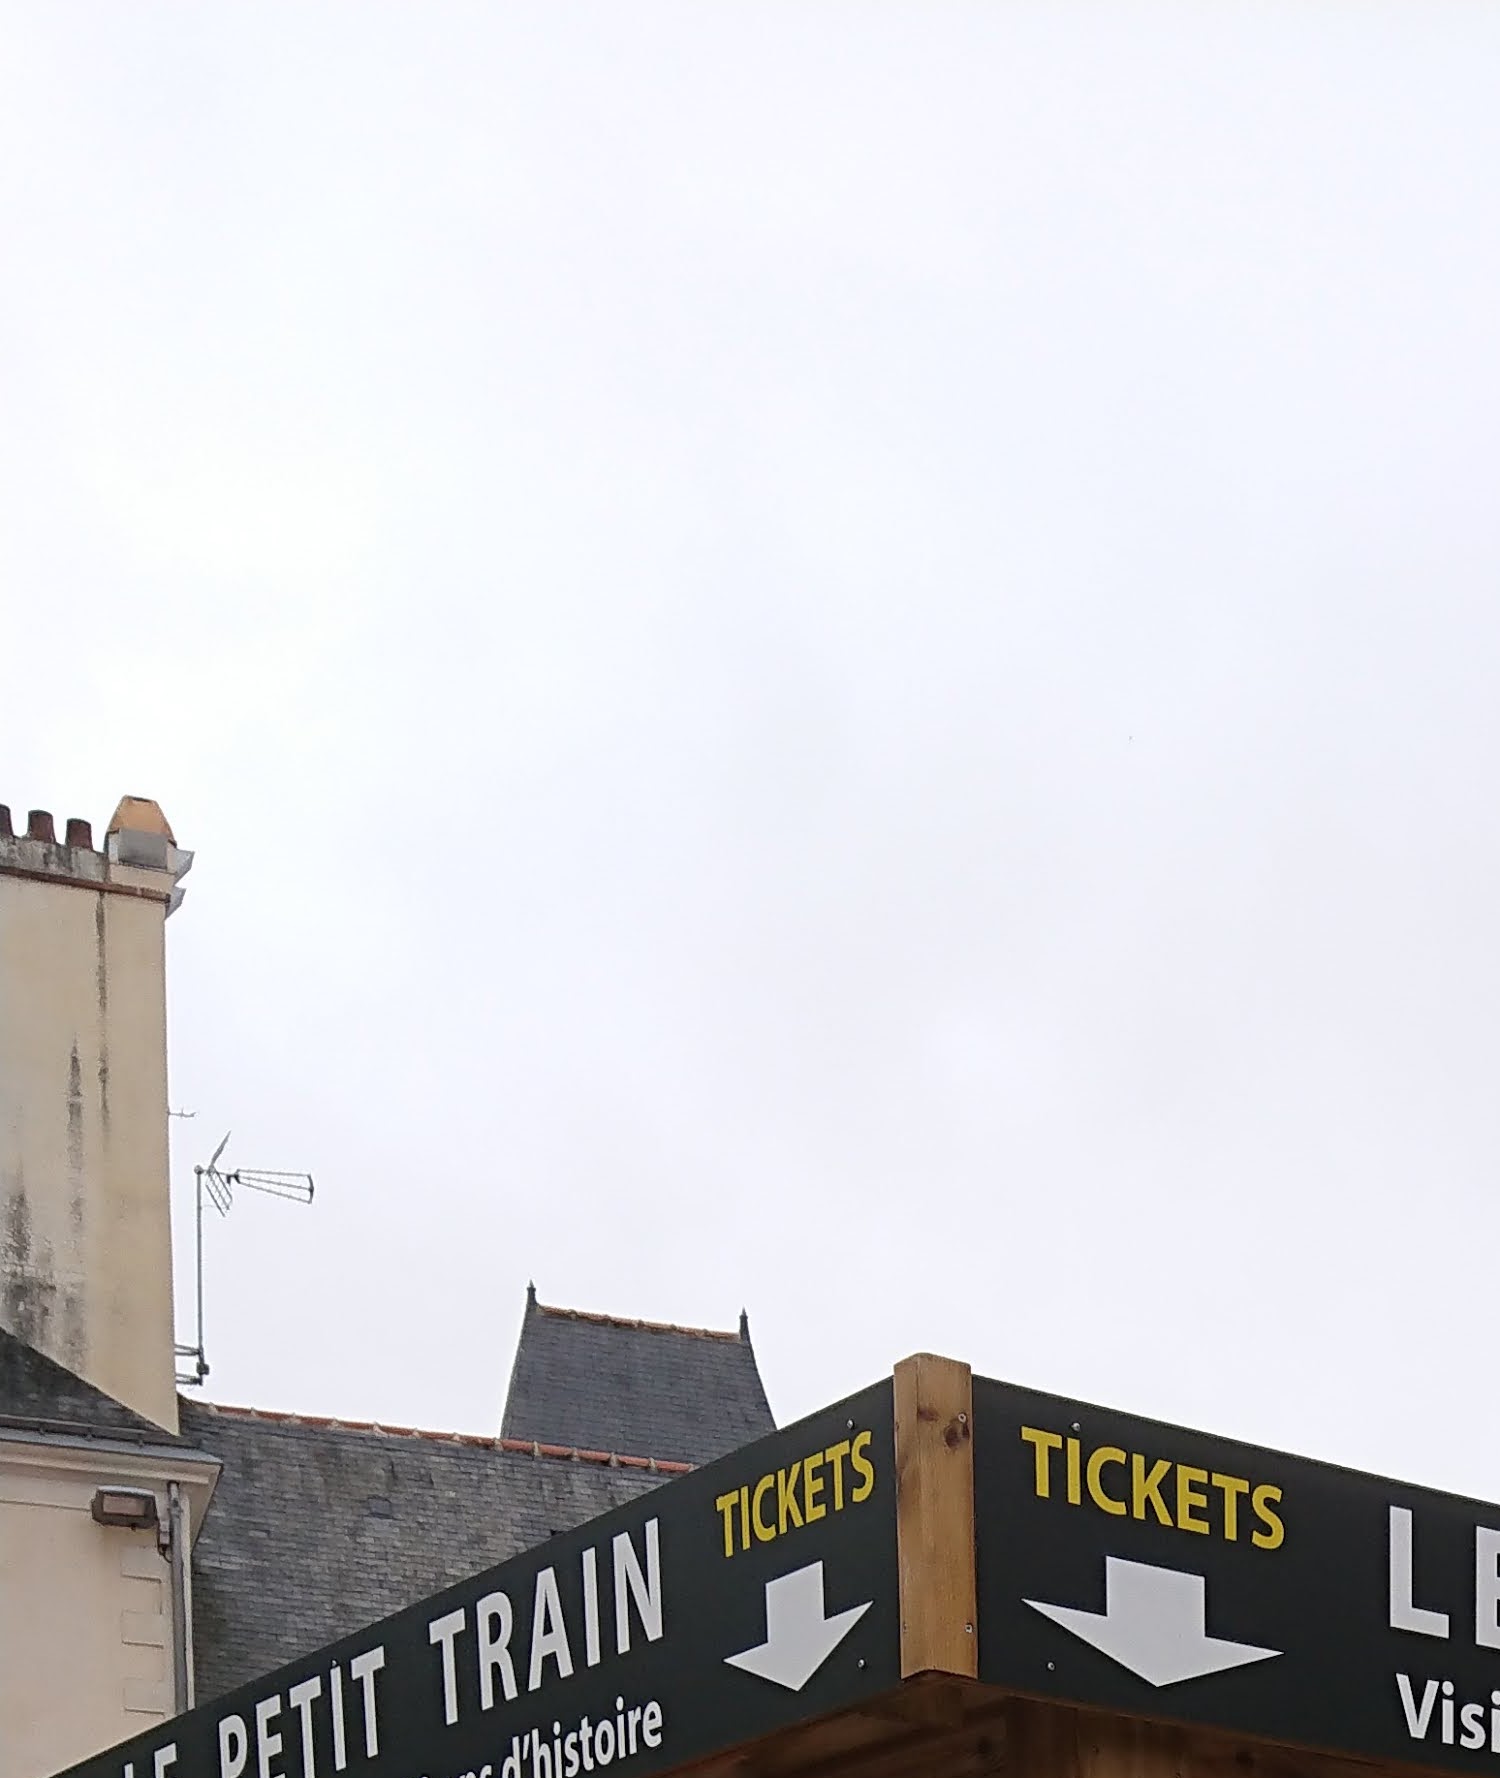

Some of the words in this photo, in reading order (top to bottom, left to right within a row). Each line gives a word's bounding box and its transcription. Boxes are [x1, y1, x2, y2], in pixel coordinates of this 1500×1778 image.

[716, 1430, 874, 1558] TICKETS
[1021, 1426, 1284, 1550] TICKETS
[428, 1518, 664, 1726] TRAIN
